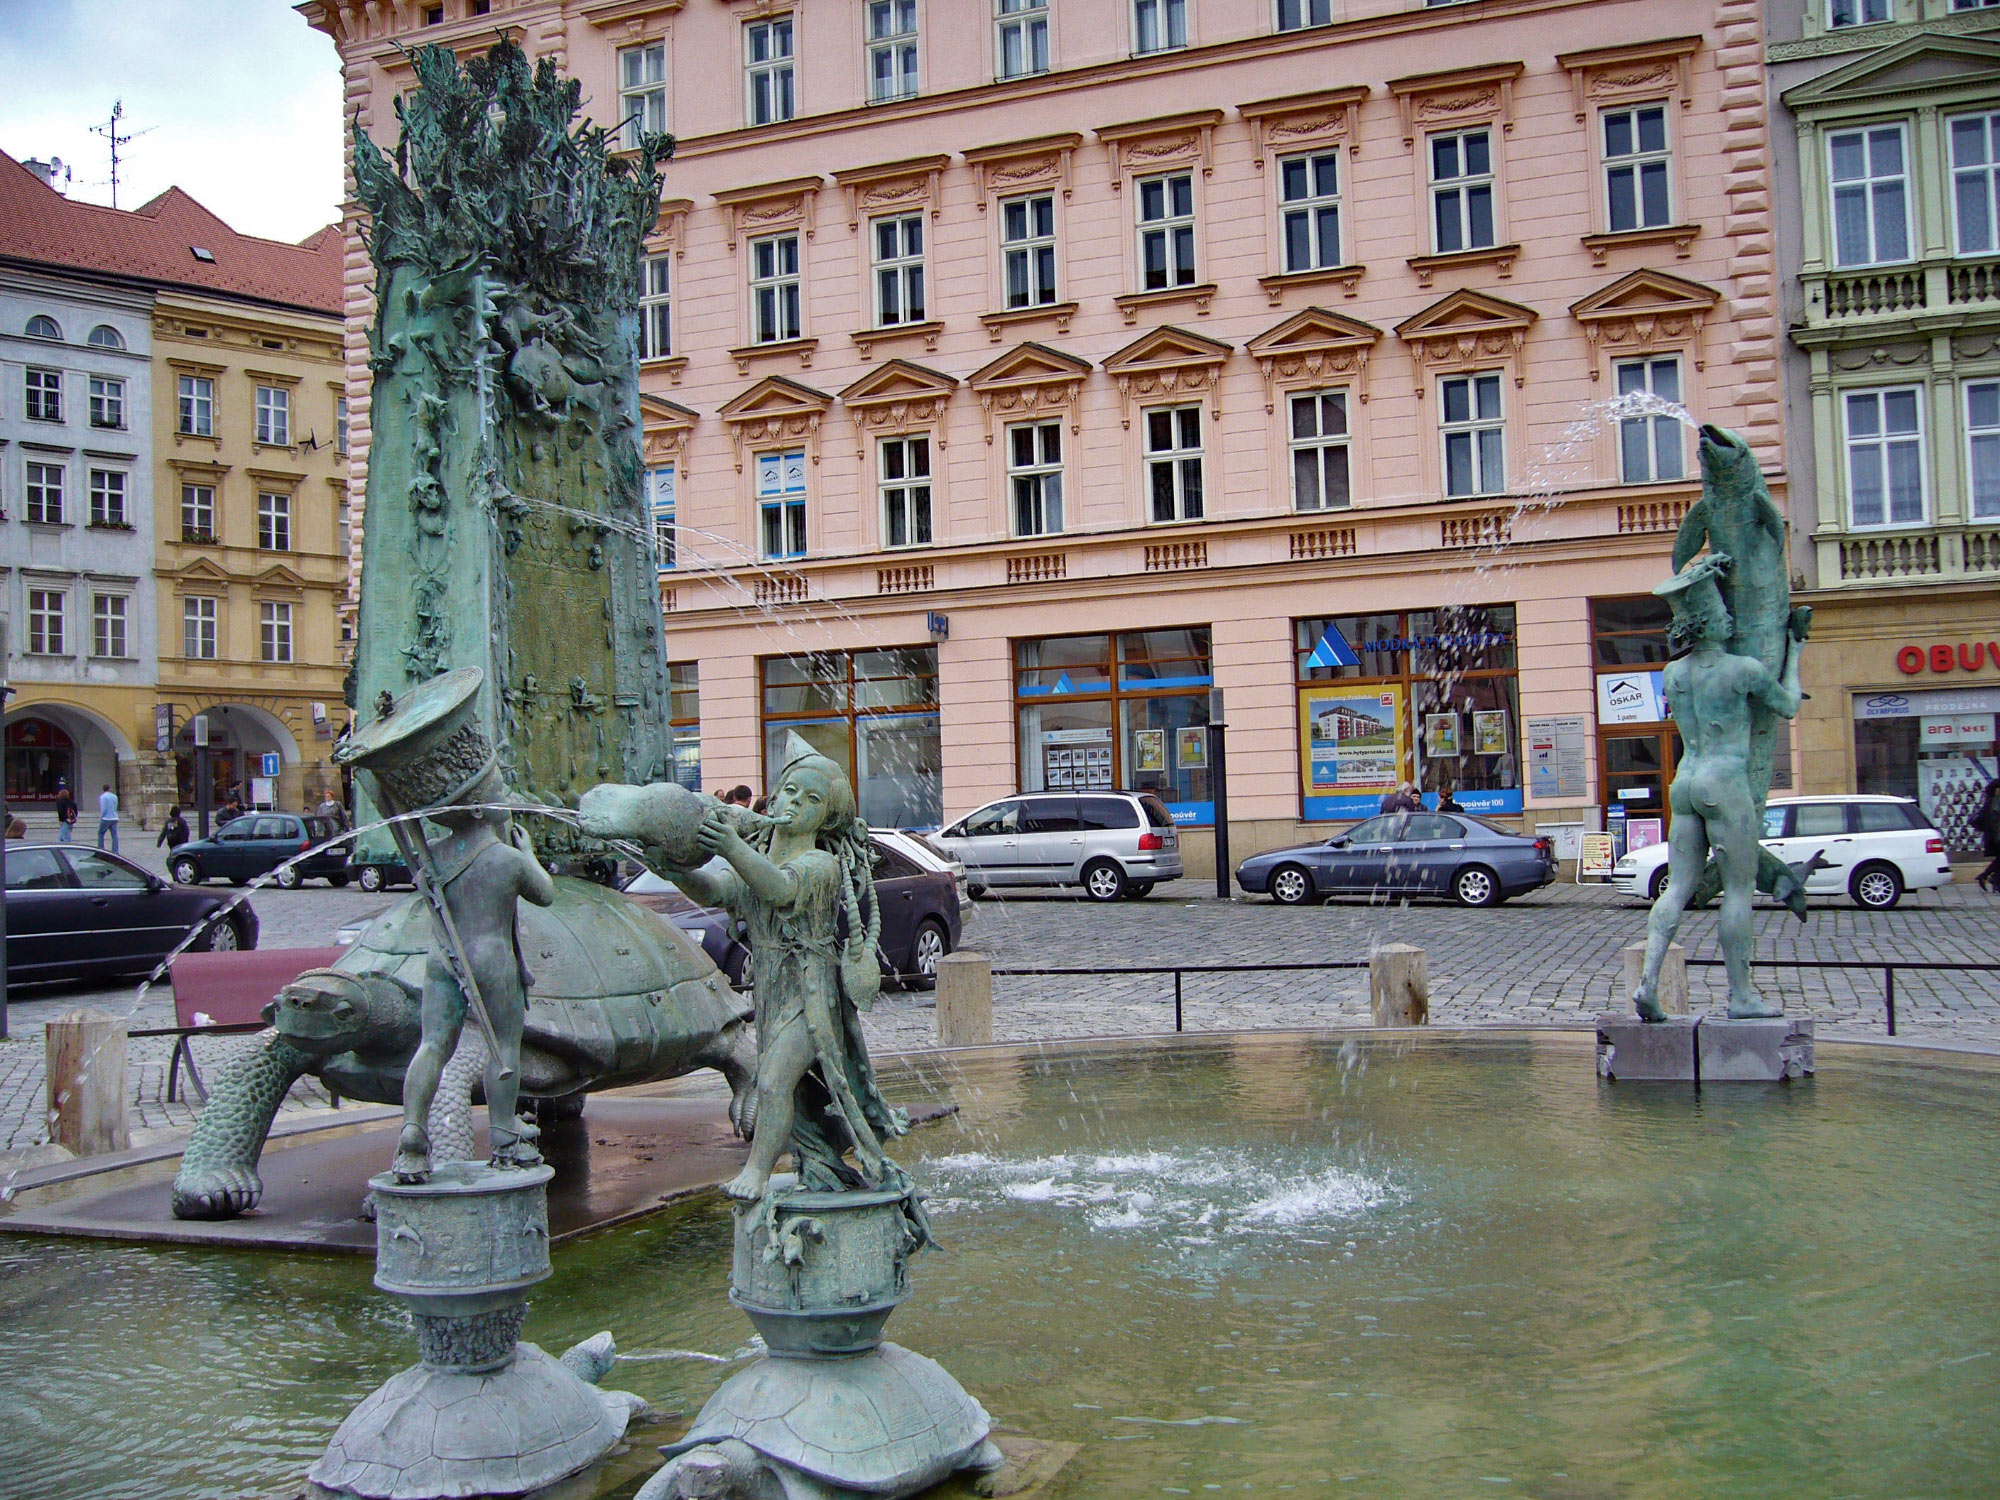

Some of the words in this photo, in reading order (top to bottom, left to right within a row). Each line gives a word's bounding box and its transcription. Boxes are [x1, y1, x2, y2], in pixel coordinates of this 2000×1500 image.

[1609, 692, 1643, 706] OSKAR
[1928, 724, 1953, 735] ara
[1491, 798, 1504, 807] 100
